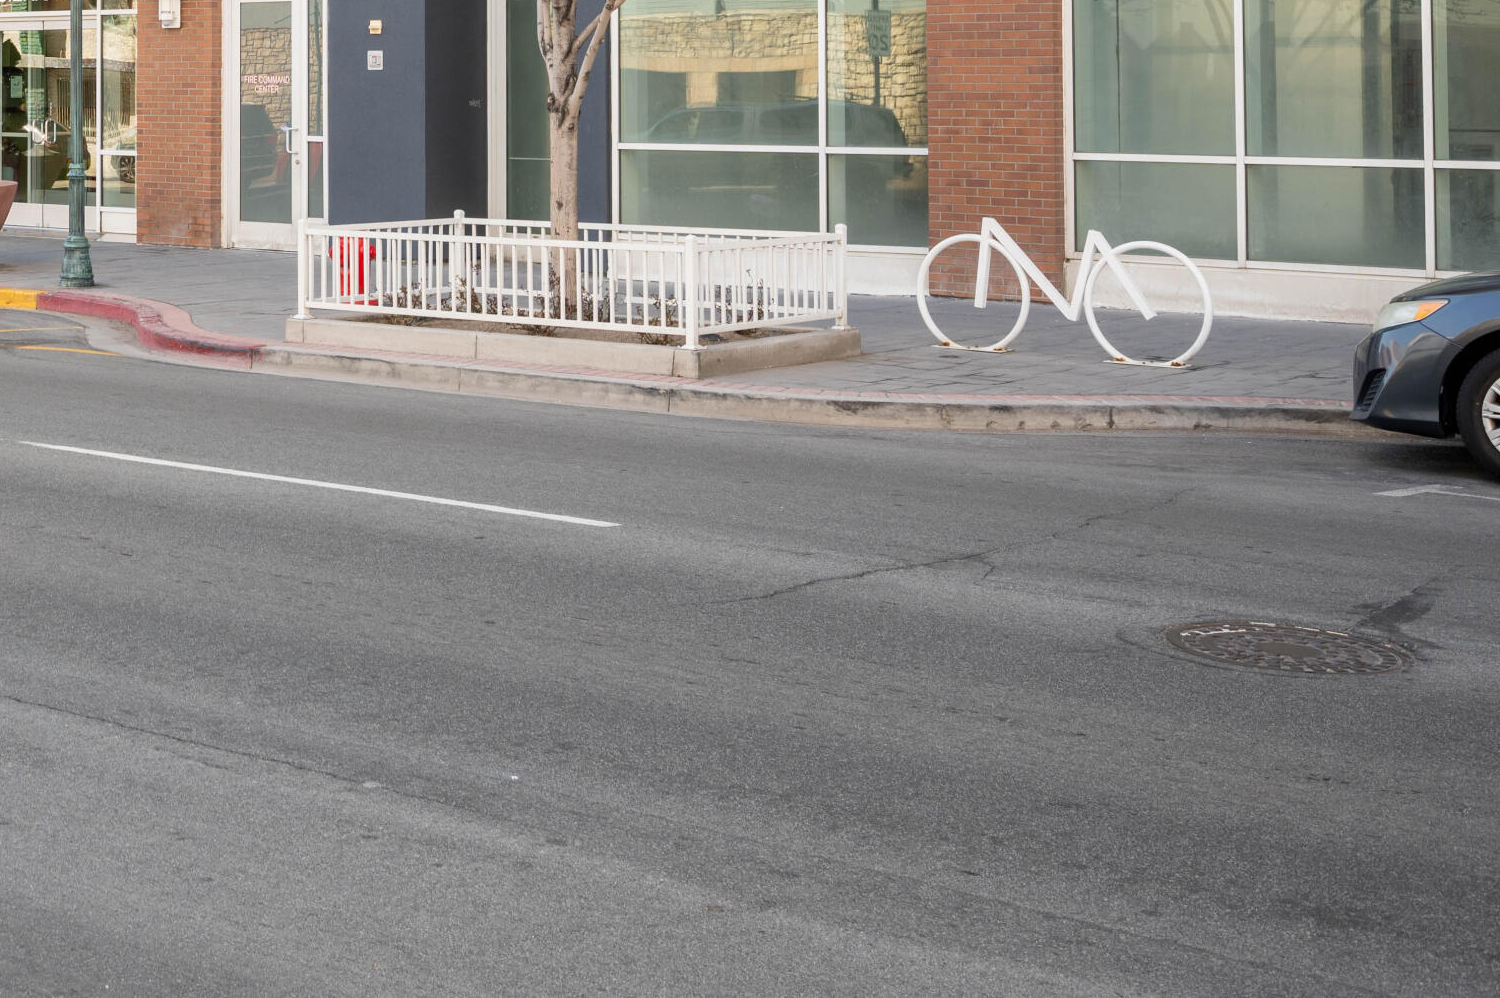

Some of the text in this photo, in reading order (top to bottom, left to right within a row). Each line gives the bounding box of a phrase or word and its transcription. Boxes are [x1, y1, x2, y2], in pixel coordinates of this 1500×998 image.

[244, 74, 290, 84] FIRE COMMAND
[254, 84, 279, 94] CENTER
